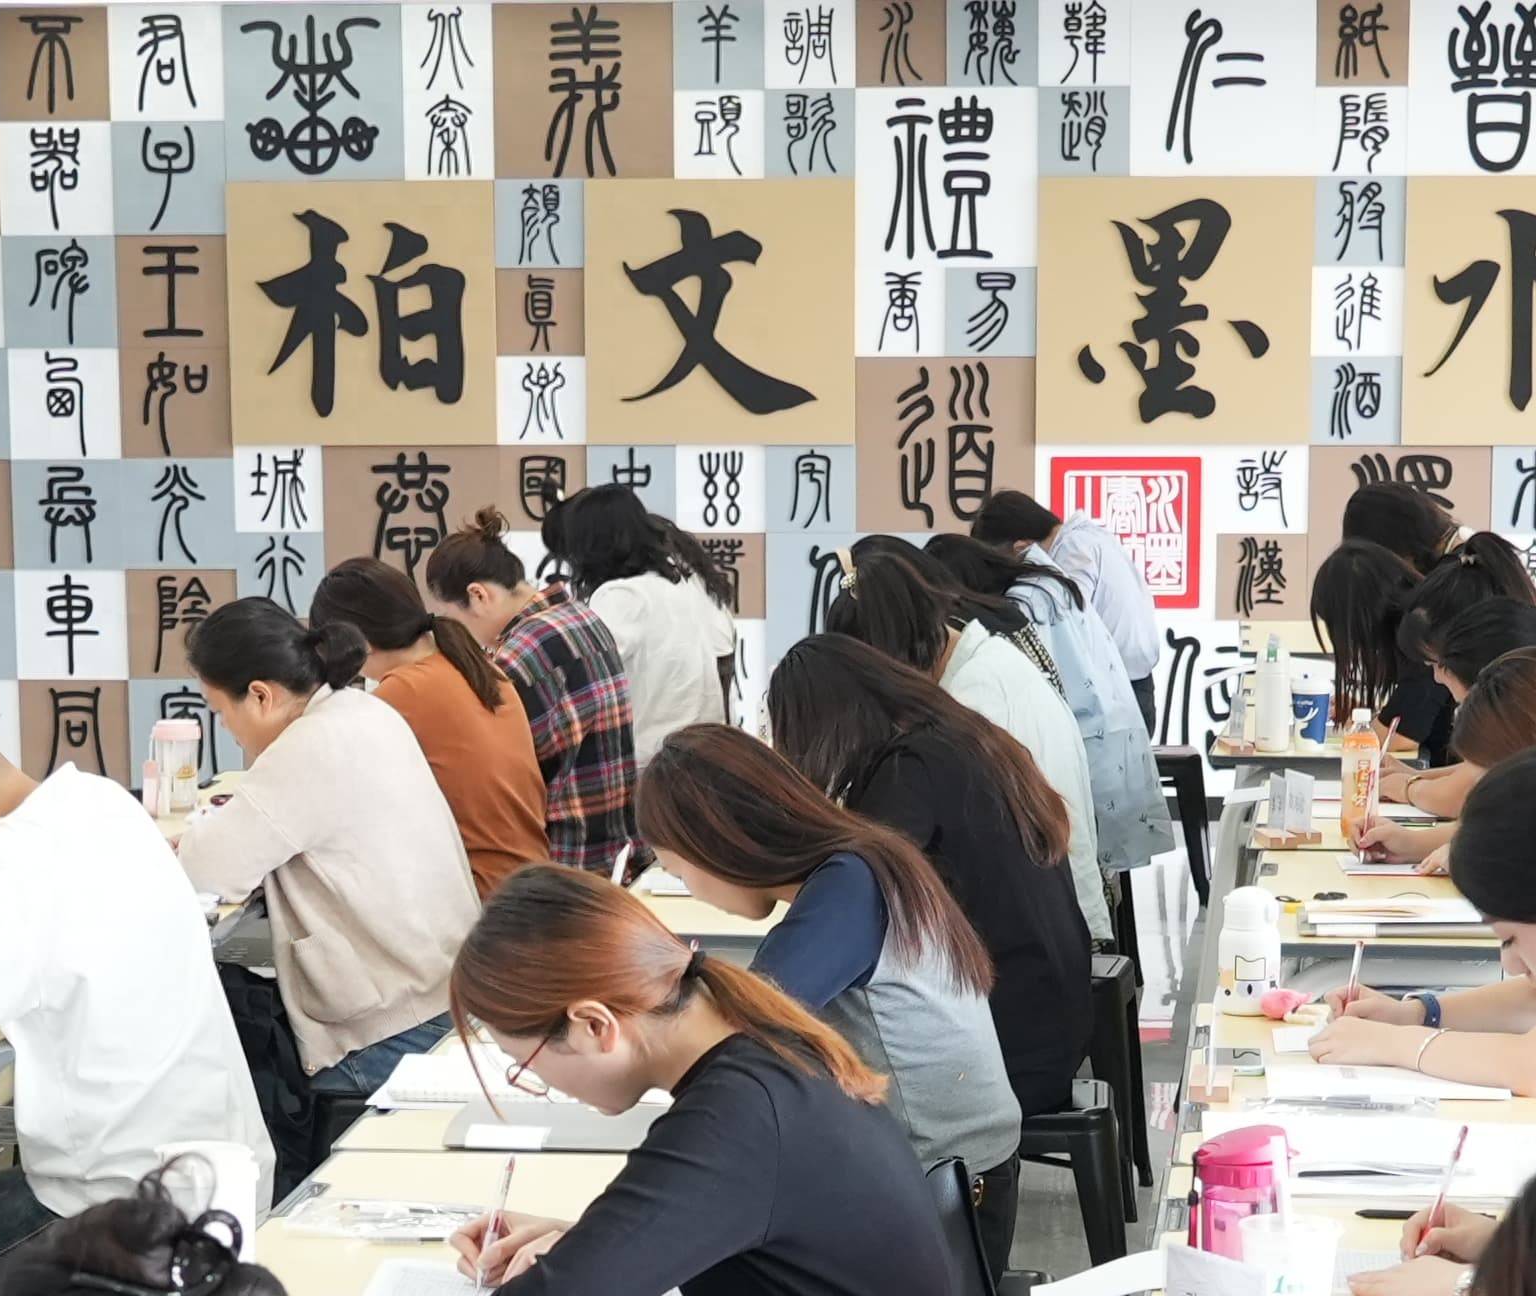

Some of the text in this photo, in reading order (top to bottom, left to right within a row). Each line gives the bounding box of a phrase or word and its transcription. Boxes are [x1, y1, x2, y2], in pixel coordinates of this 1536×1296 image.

[17, 14, 84, 115] 不
[137, 14, 197, 112] 君
[783, 4, 837, 84] 調
[879, 0, 923, 86] 水
[1060, 0, 1107, 84] 韓
[1335, 2, 1390, 79] 紙
[544, 4, 622, 179] 義
[1165, 8, 1267, 164] 仁
[694, 95, 742, 176] 頭
[783, 92, 837, 175] 歌
[1061, 90, 1109, 172] 趙
[30, 127, 80, 230] 器
[141, 125, 195, 231] 子
[884, 94, 994, 260] 禮
[518, 183, 560, 265] 顏
[1334, 181, 1386, 261] 將
[255, 209, 466, 418] 柏
[620, 208, 818, 416] 文
[1077, 198, 1270, 424] 墨
[878, 271, 922, 352] 唐
[966, 271, 1017, 353] 易
[1335, 272, 1382, 351] 進
[1330, 362, 1381, 440] 酒
[896, 361, 996, 529] 道
[38, 466, 97, 564] 兵
[151, 464, 206, 565] 光
[250, 449, 308, 529] 城
[256, 537, 306, 615] 行
[1235, 536, 1287, 618] 漢
[45, 573, 100, 676] 車
